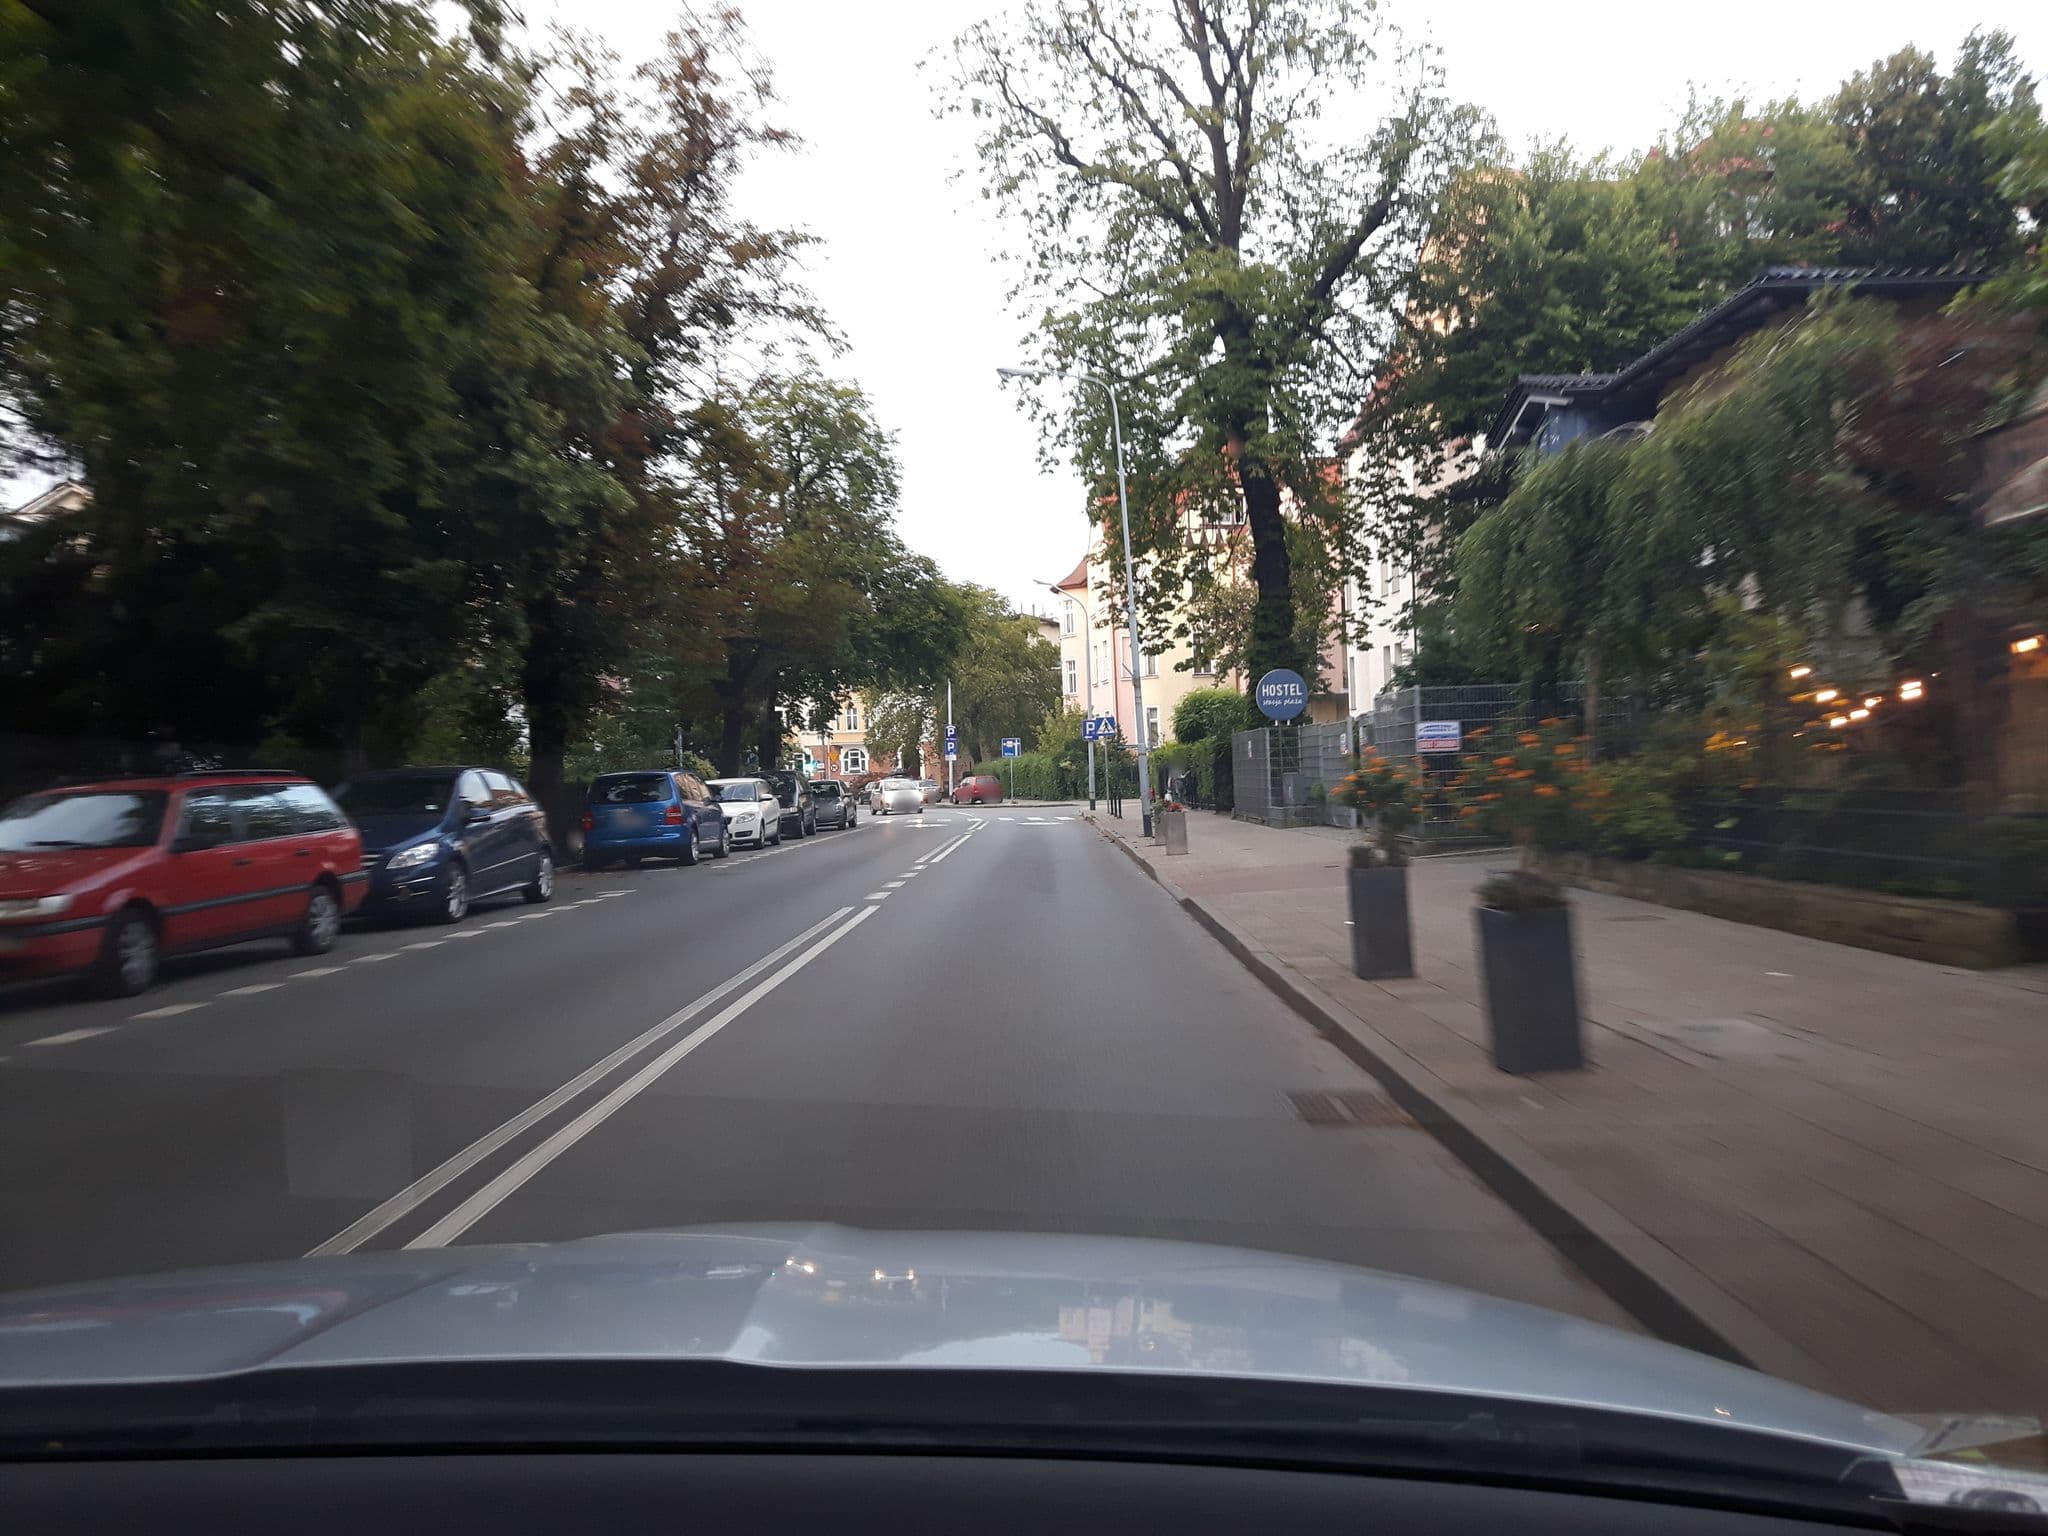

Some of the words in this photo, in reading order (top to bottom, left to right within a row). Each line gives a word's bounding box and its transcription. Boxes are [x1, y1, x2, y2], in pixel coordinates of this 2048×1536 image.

[1262, 683, 1303, 697] HOSTEL
[947, 728, 955, 737] P
[1086, 721, 1095, 735] P
[947, 742, 955, 752] P
